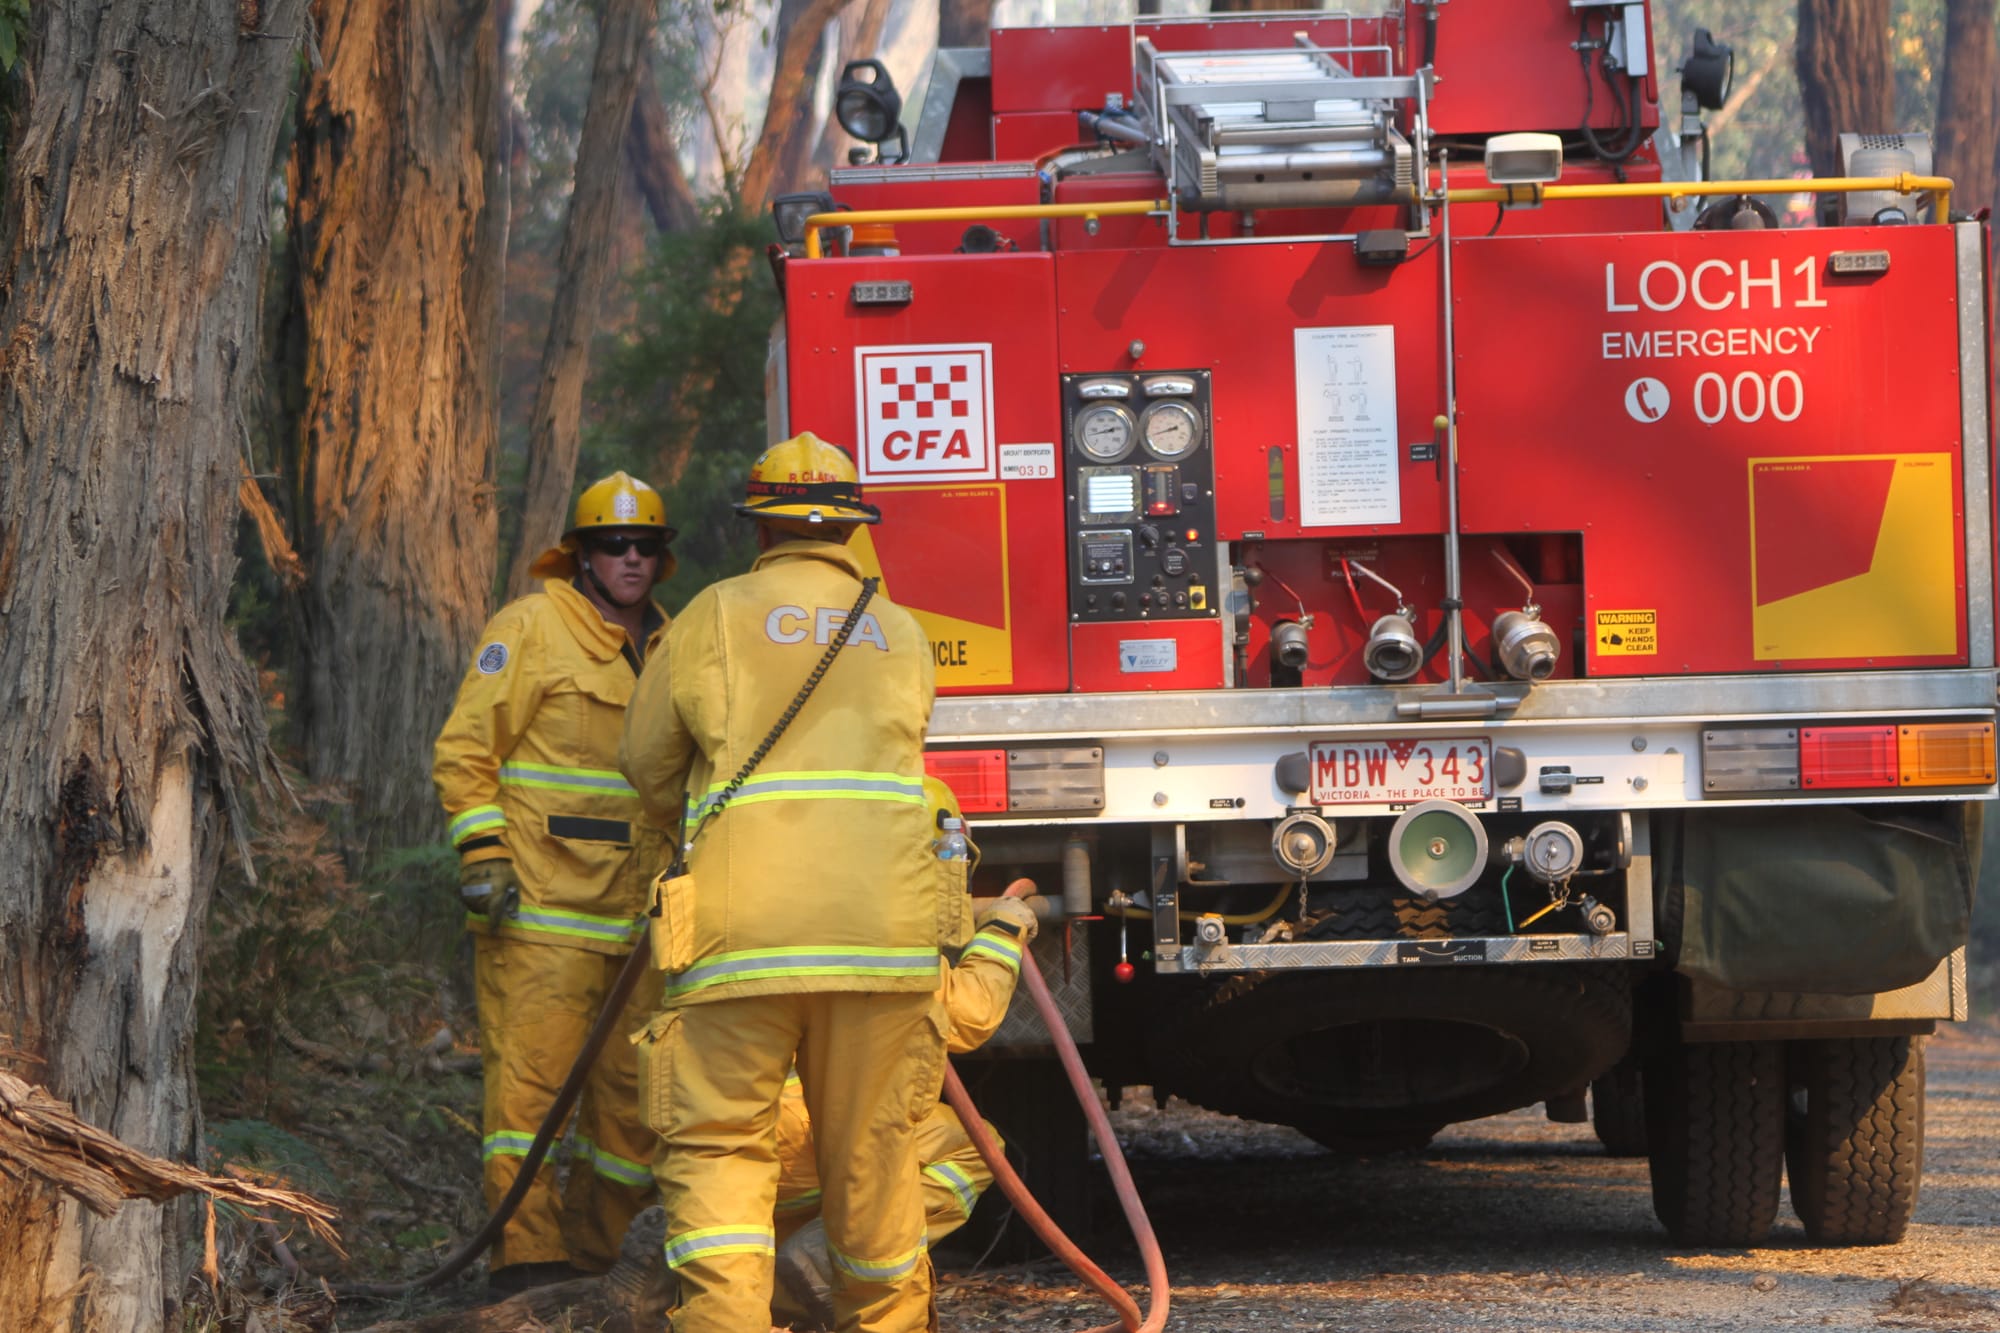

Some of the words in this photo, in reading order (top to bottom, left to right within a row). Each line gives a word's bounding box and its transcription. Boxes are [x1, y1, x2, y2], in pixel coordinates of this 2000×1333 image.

[1602, 326, 1821, 359] EMERGENCY
[1694, 370, 1804, 424] 000
[882, 429, 971, 462] CFA
[1019, 465, 1034, 476] 03
[1039, 465, 1048, 476] D
[765, 604, 890, 652] CFA
[1599, 613, 1654, 624] WARNING
[1625, 635, 1654, 643] HANDS
[1628, 627, 1650, 635] KEEP
[928, 640, 968, 667] ICLE
[1625, 644, 1654, 652] CLEAR
[1317, 749, 1389, 788] MBW
[1417, 745, 1484, 786] 343
[1319, 790, 1370, 801] VICTORIA
[1387, 789, 1407, 798] THE
[1413, 788, 1446, 798] PLACE
[1452, 787, 1465, 797] TO
[1472, 786, 1485, 796] BE
